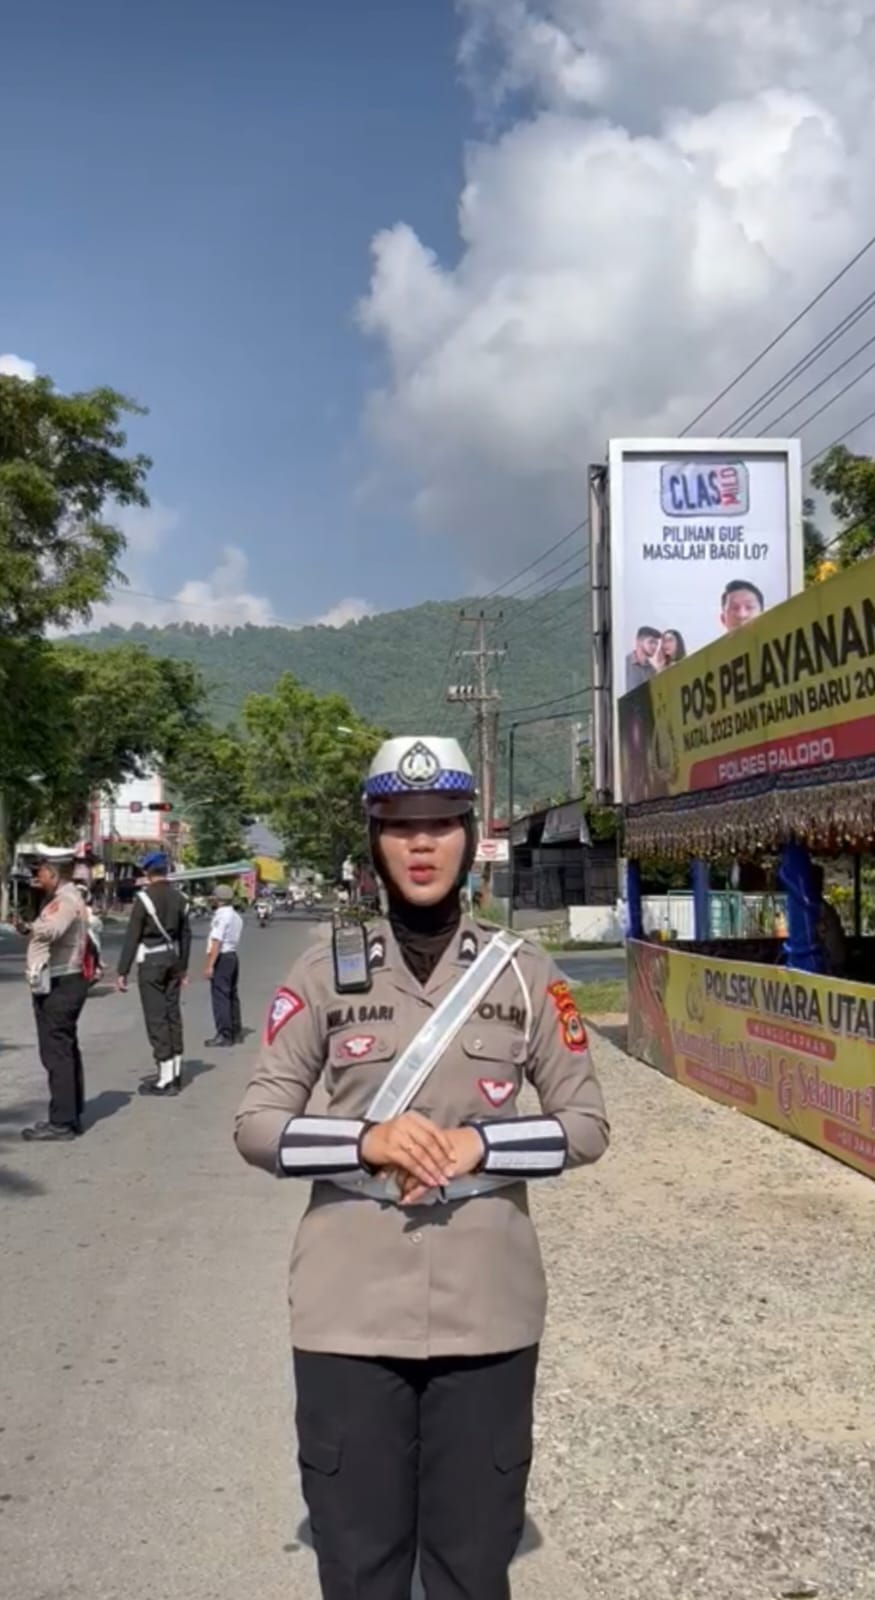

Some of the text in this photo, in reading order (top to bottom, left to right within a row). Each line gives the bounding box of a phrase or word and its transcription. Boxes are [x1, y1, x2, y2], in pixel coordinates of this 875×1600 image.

[643, 543, 769, 560] MASALAH BAGI LO?
[662, 525, 745, 542] PILIHAN GUE
[680, 671, 717, 726] POS
[735, 706, 759, 735] DAN
[759, 691, 805, 727] TAHUN
[806, 674, 850, 713] BARU
[717, 736, 835, 781] POLRES PALOPO
[704, 968, 875, 1042] POLSEK WARA UTA
